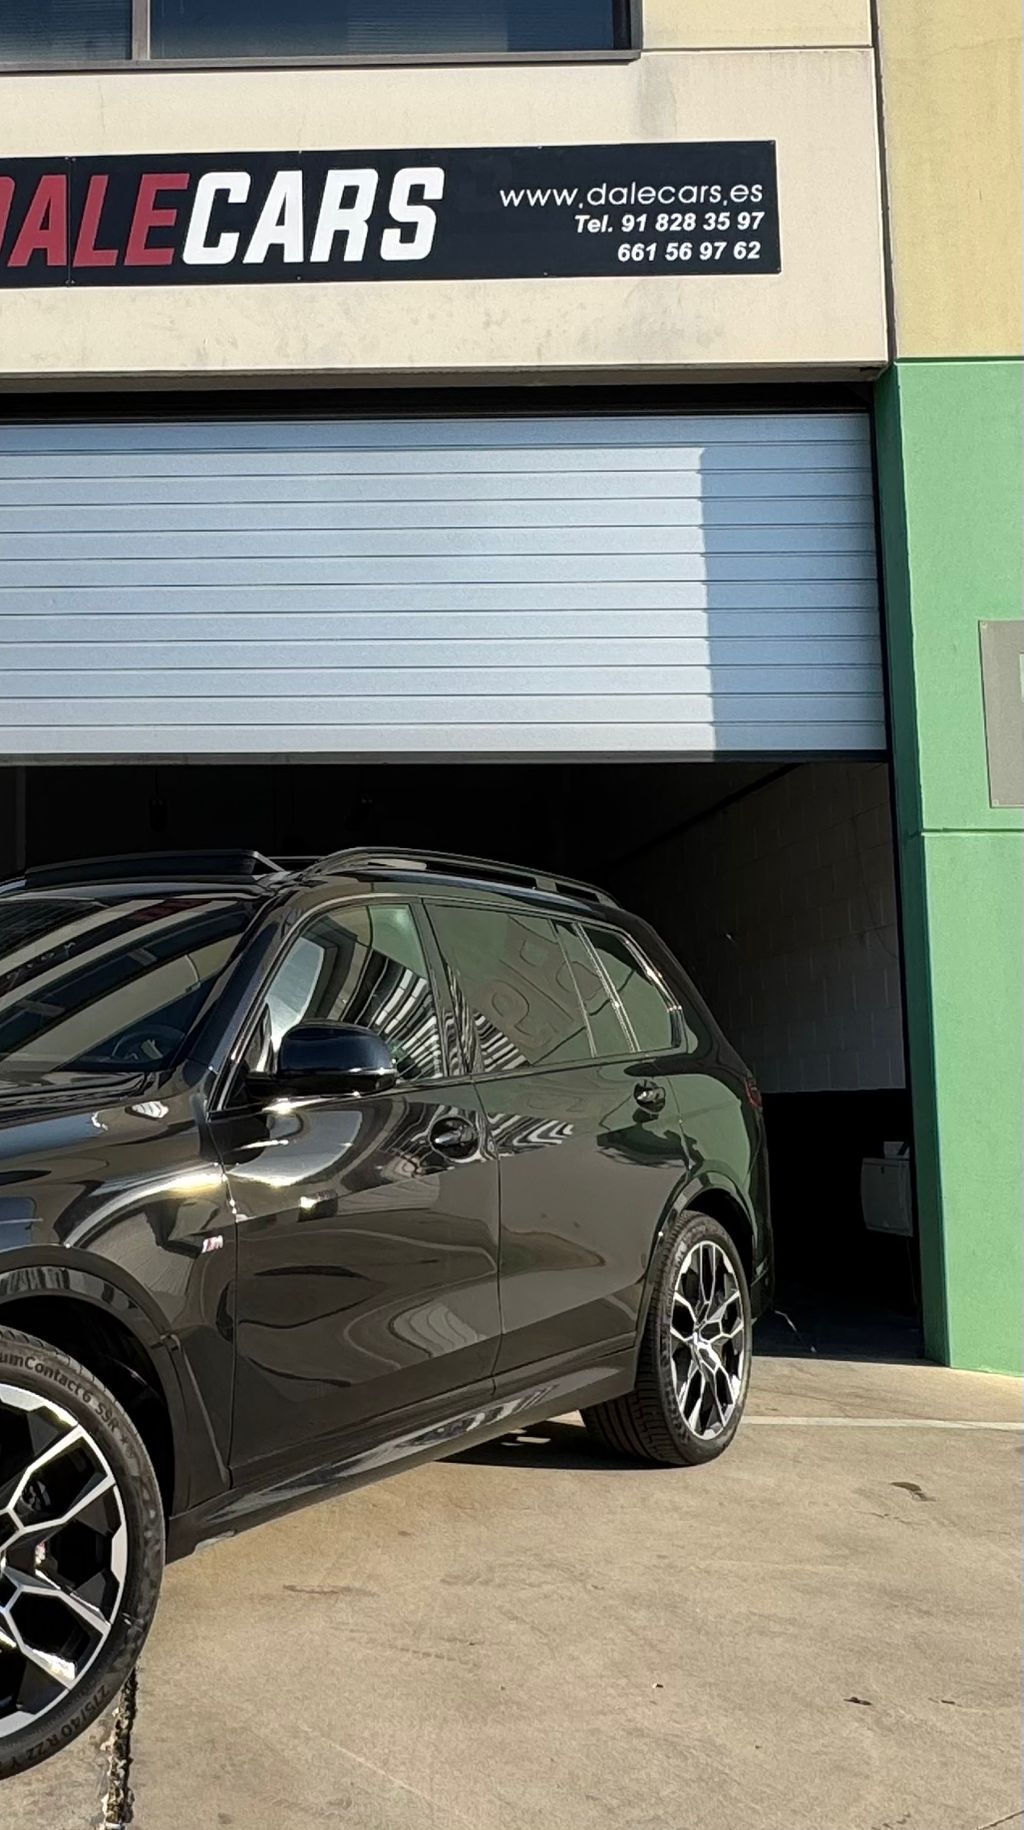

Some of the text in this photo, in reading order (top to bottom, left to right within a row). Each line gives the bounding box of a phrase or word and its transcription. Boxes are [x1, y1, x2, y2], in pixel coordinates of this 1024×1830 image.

[499, 181, 764, 209] www.dalecars.es
[574, 211, 765, 233] Tel. 91 828 35 97
[617, 240, 761, 262] 661 56 97 62
